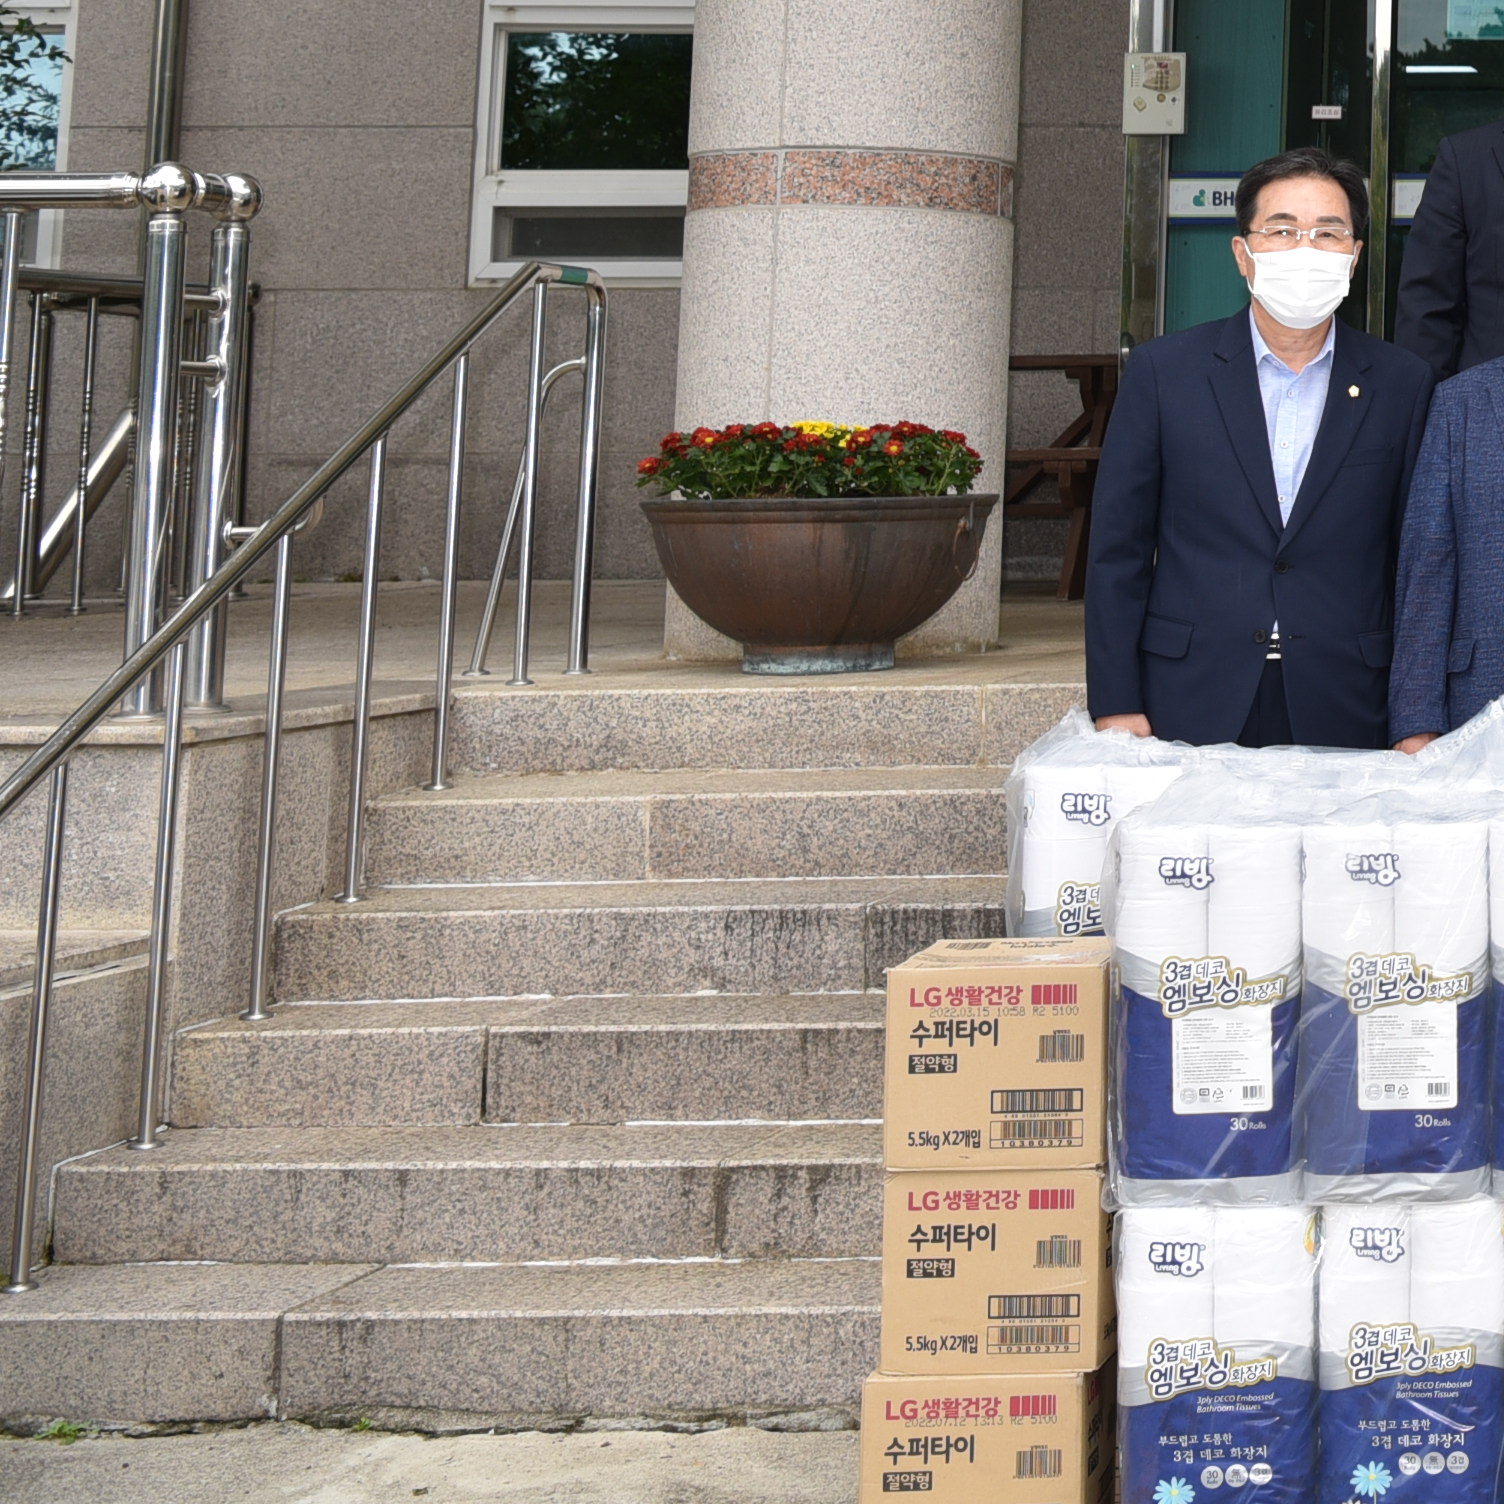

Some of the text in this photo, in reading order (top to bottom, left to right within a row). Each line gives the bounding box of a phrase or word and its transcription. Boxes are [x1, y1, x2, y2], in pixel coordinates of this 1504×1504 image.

[1212, 191, 1235, 207] BH
[1166, 960, 1224, 982] 3겹 데코
[910, 985, 1023, 1007] LG 생활건강
[1163, 973, 1283, 1013] 엠보싱 화장지
[929, 1006, 990, 1018] 2022.03.15
[1052, 1006, 1079, 1016] 5100
[910, 1018, 999, 1048] 수퍼타이
[912, 1055, 954, 1073] 절약형
[1230, 1118, 1248, 1131] 30
[908, 1130, 939, 1151] 5.5kg
[908, 1189, 1021, 1211] LG 생활건강
[908, 1223, 996, 1252] 수퍼타이
[909, 1260, 953, 1277] 절약형
[905, 1335, 937, 1355] 5.5kg
[886, 1397, 1001, 1420] LG 생활건강
[884, 1434, 974, 1466] 수퍼타이
[886, 1473, 930, 1491] 절약형
